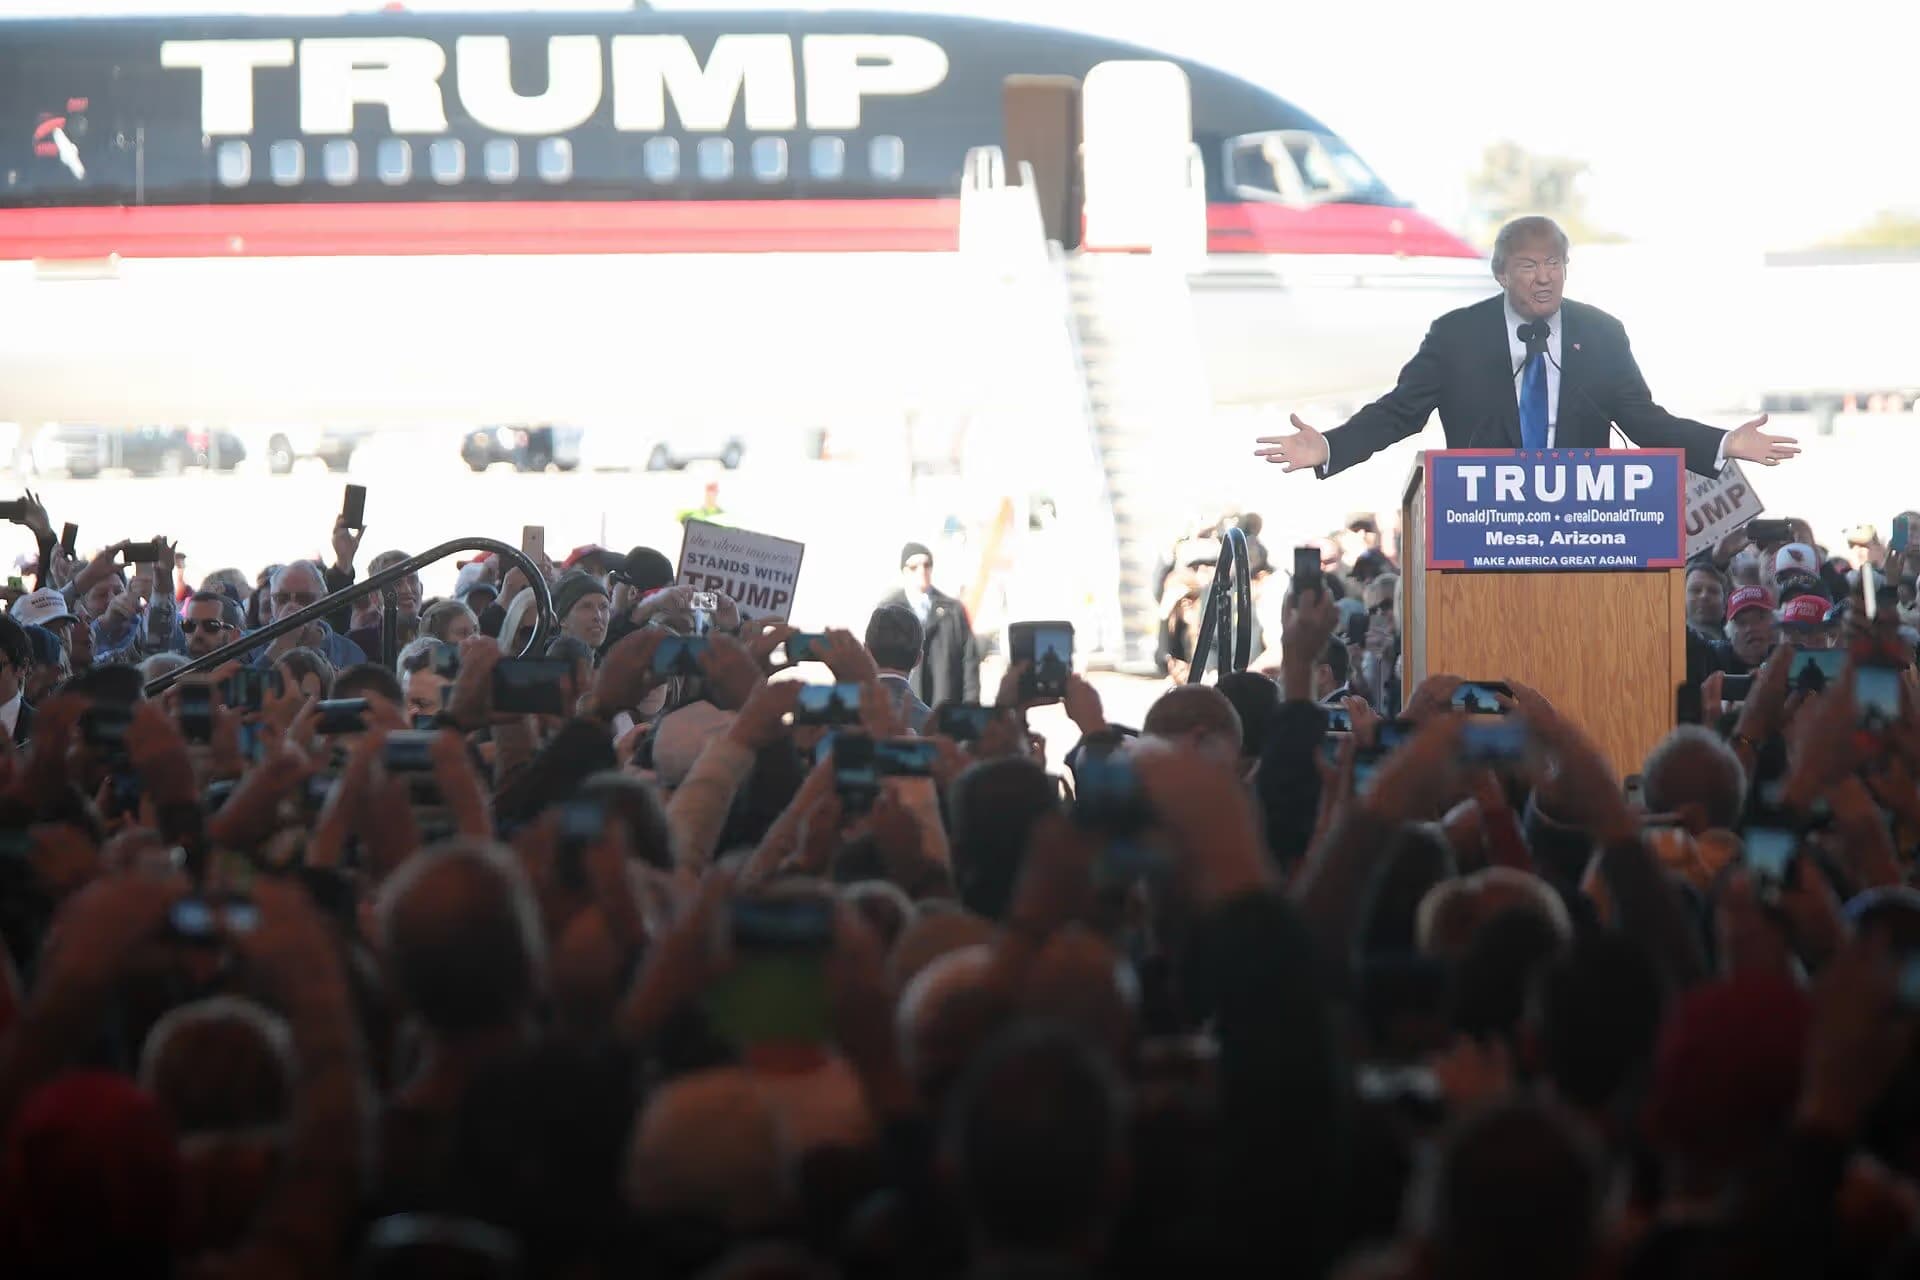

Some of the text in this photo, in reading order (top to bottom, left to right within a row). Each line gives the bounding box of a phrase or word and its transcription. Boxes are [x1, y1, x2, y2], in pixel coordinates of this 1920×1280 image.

[161, 34, 949, 134] TRUMP
[1457, 465, 1654, 502] TRUMP
[1447, 508, 1665, 525] DonaldJTrump.com @realDonaldTrump
[1686, 482, 1746, 536] UMP
[1486, 531, 1626, 547] Mesa, Arizona
[687, 551, 793, 585] STANDS WITH
[1473, 555, 1637, 566] MAKE AMERICA GREAT AGAIN!
